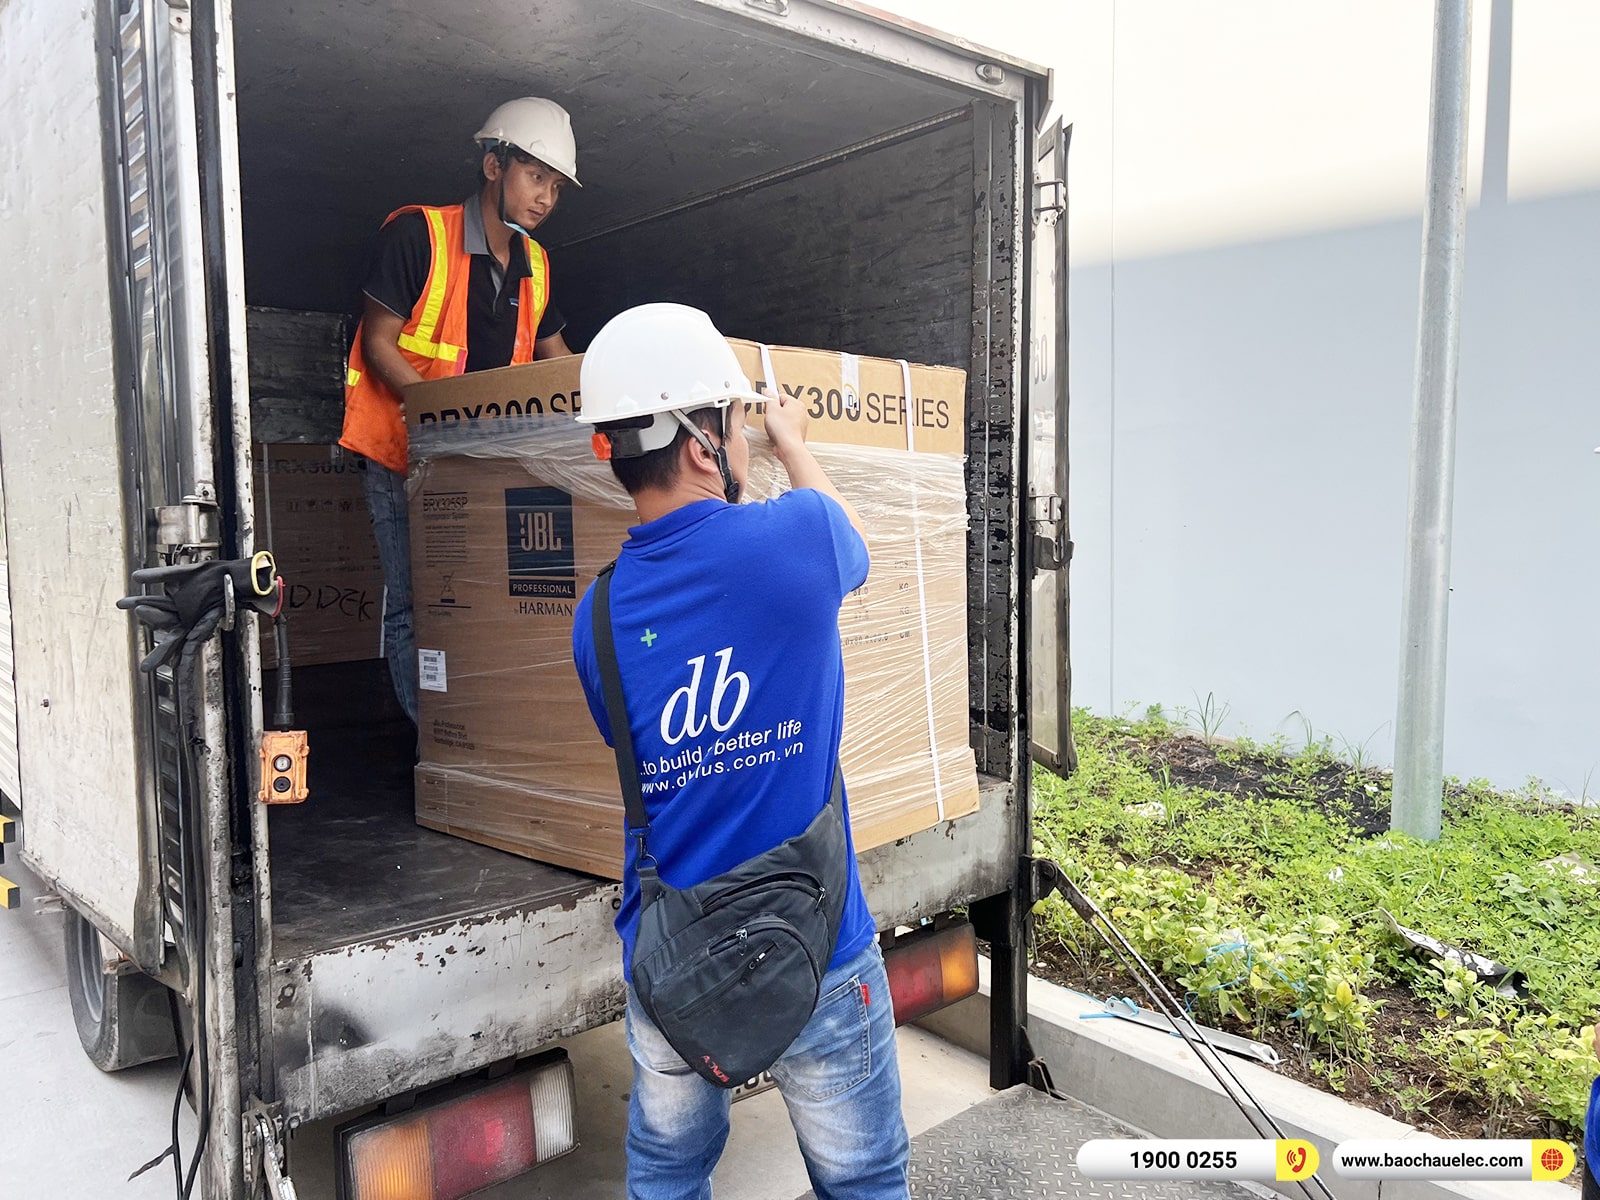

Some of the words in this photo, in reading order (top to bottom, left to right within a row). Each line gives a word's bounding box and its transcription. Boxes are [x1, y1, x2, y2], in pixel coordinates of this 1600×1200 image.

[519, 512, 563, 552] JBL
[512, 583, 573, 595] PROFESSIONAL
[519, 601, 574, 617] HARMAN
[660, 646, 751, 746] db
[659, 745, 703, 774] build
[713, 728, 773, 757] better
[777, 719, 802, 741] life
